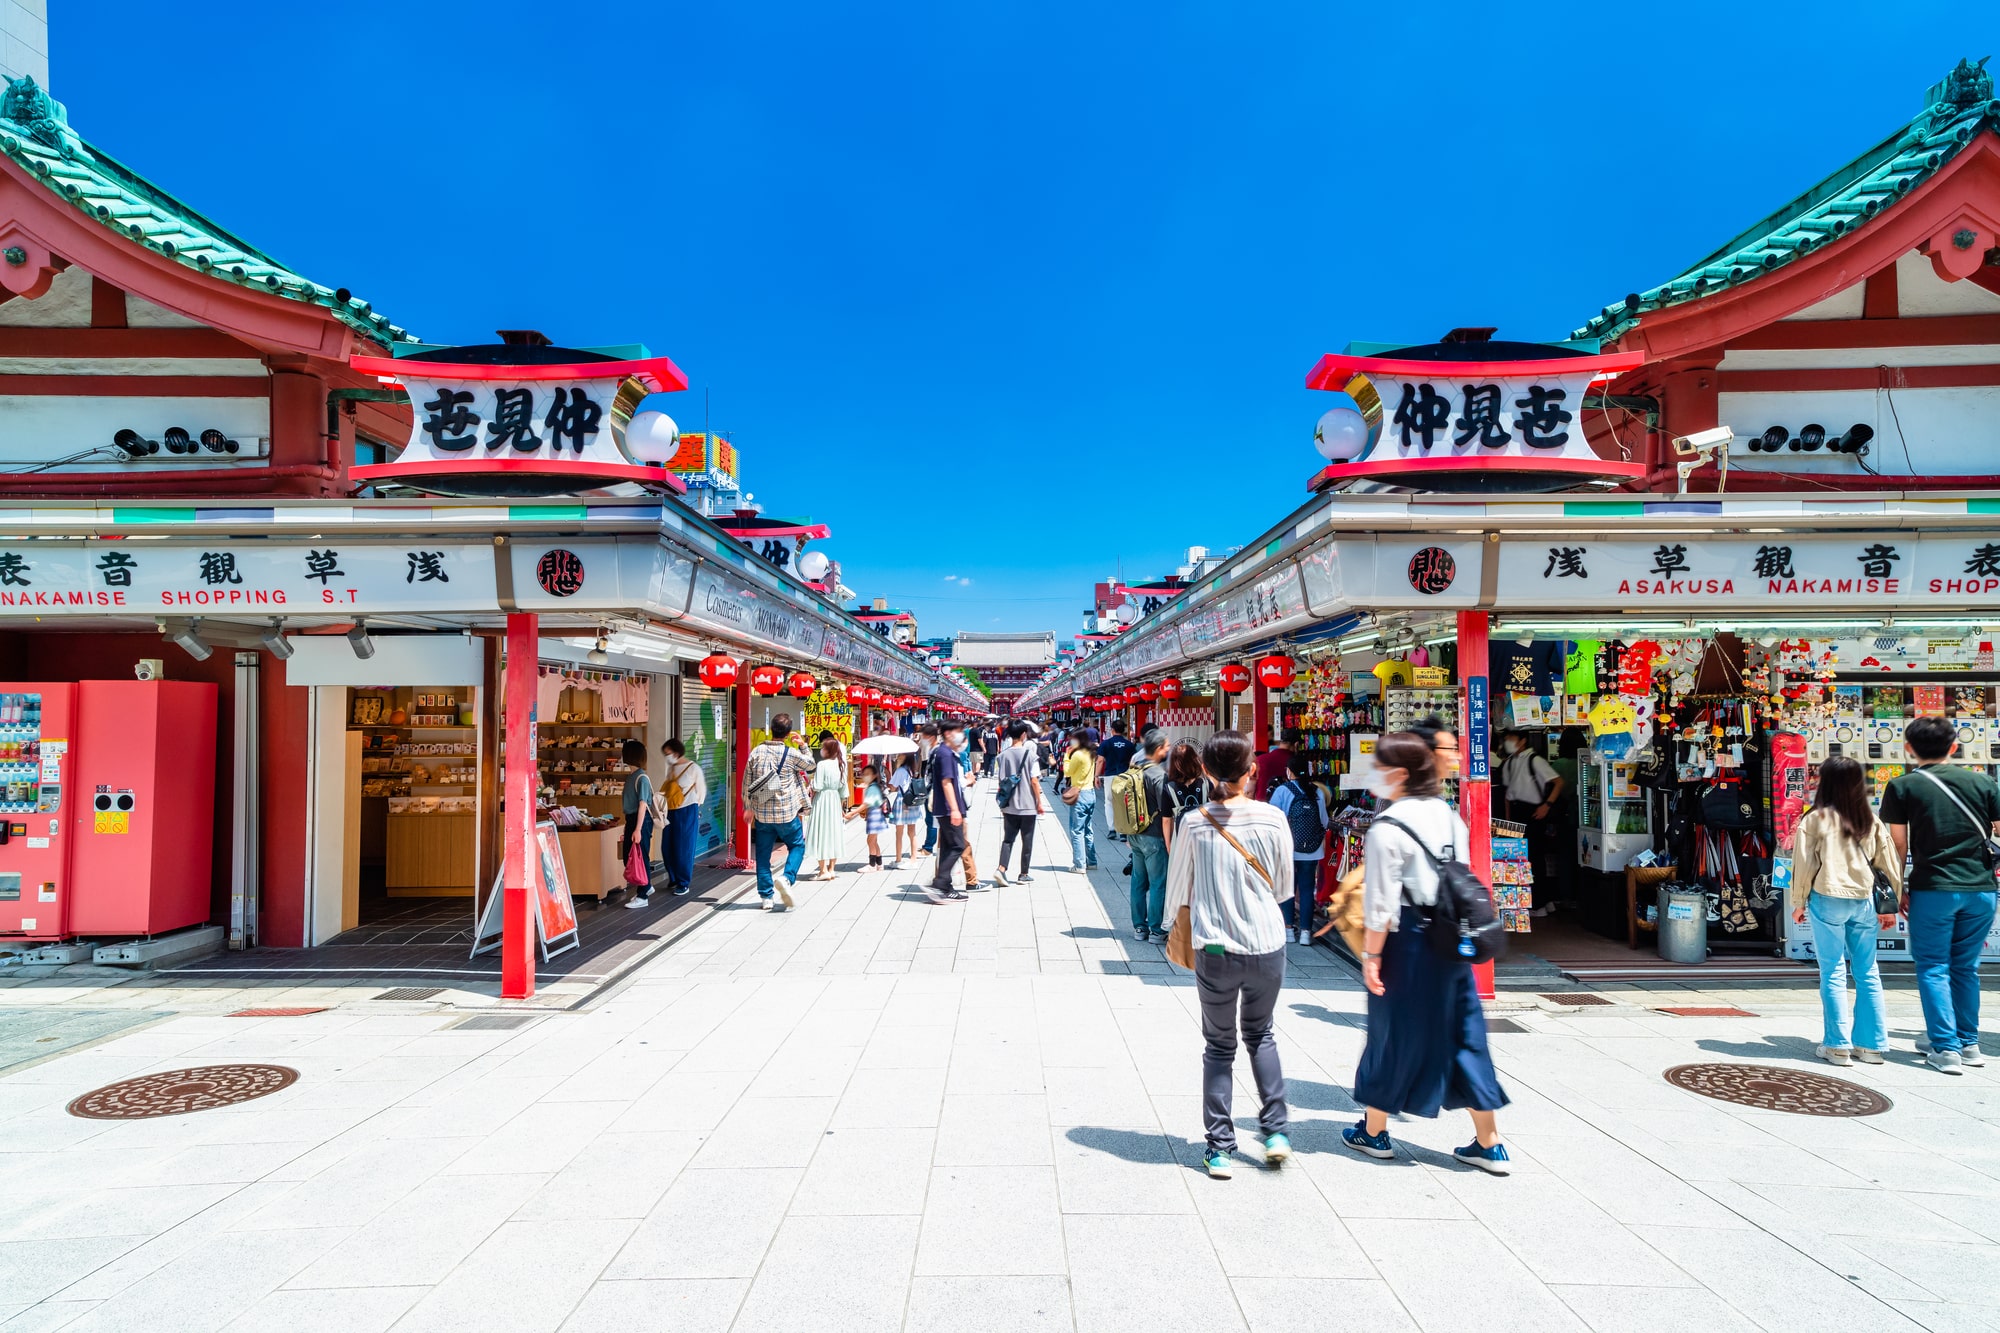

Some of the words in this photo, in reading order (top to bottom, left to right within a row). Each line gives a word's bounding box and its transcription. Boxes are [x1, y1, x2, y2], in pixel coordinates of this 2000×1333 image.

[1393, 383, 1573, 449] 仲見世
[1, 591, 126, 606] NAKAMISE
[161, 589, 286, 605] SHOPPING
[322, 589, 358, 603] S.T
[1618, 579, 1734, 594] ASAKUSA
[1768, 579, 1899, 593] NAKAMISE
[706, 584, 743, 623] Cosmetics
[1474, 700, 1483, 754] 浅草一丁目
[1473, 762, 1485, 773] 18
